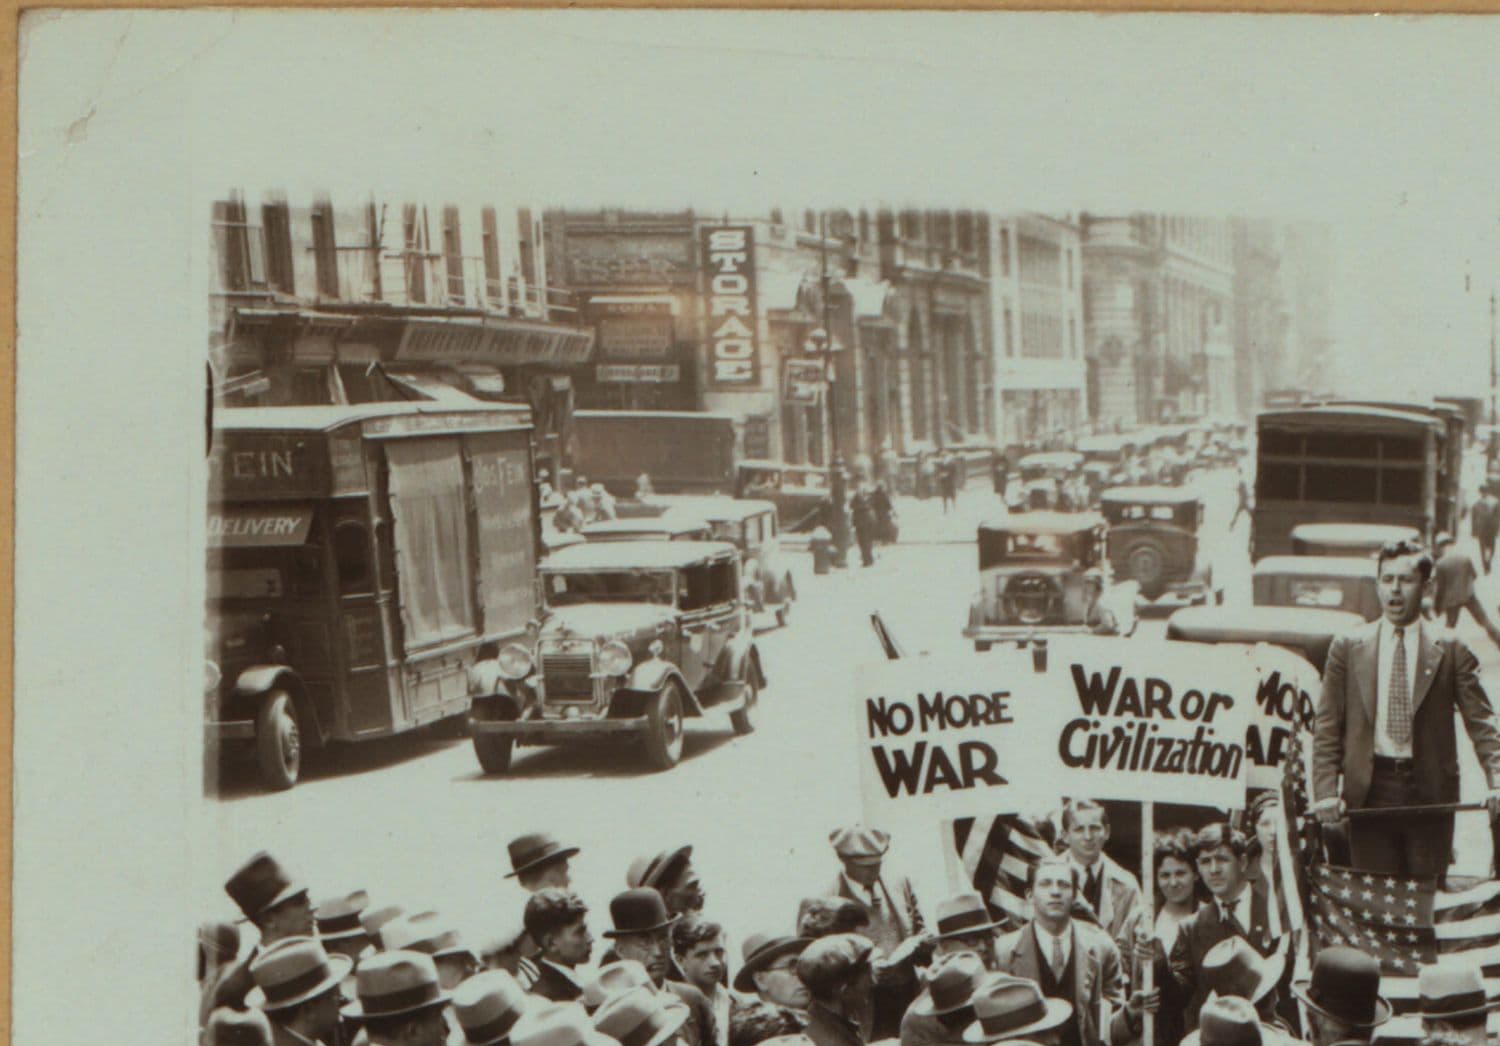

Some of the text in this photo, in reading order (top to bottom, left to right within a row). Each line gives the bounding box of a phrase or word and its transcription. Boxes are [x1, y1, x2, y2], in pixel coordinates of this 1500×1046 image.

[709, 230, 754, 381] STORAGE
[206, 516, 302, 538] DELIVERY
[917, 690, 1014, 731] MORE
[1070, 663, 1177, 719] WAR
[871, 740, 1009, 798] WAR
[1057, 718, 1244, 780] Civilization
